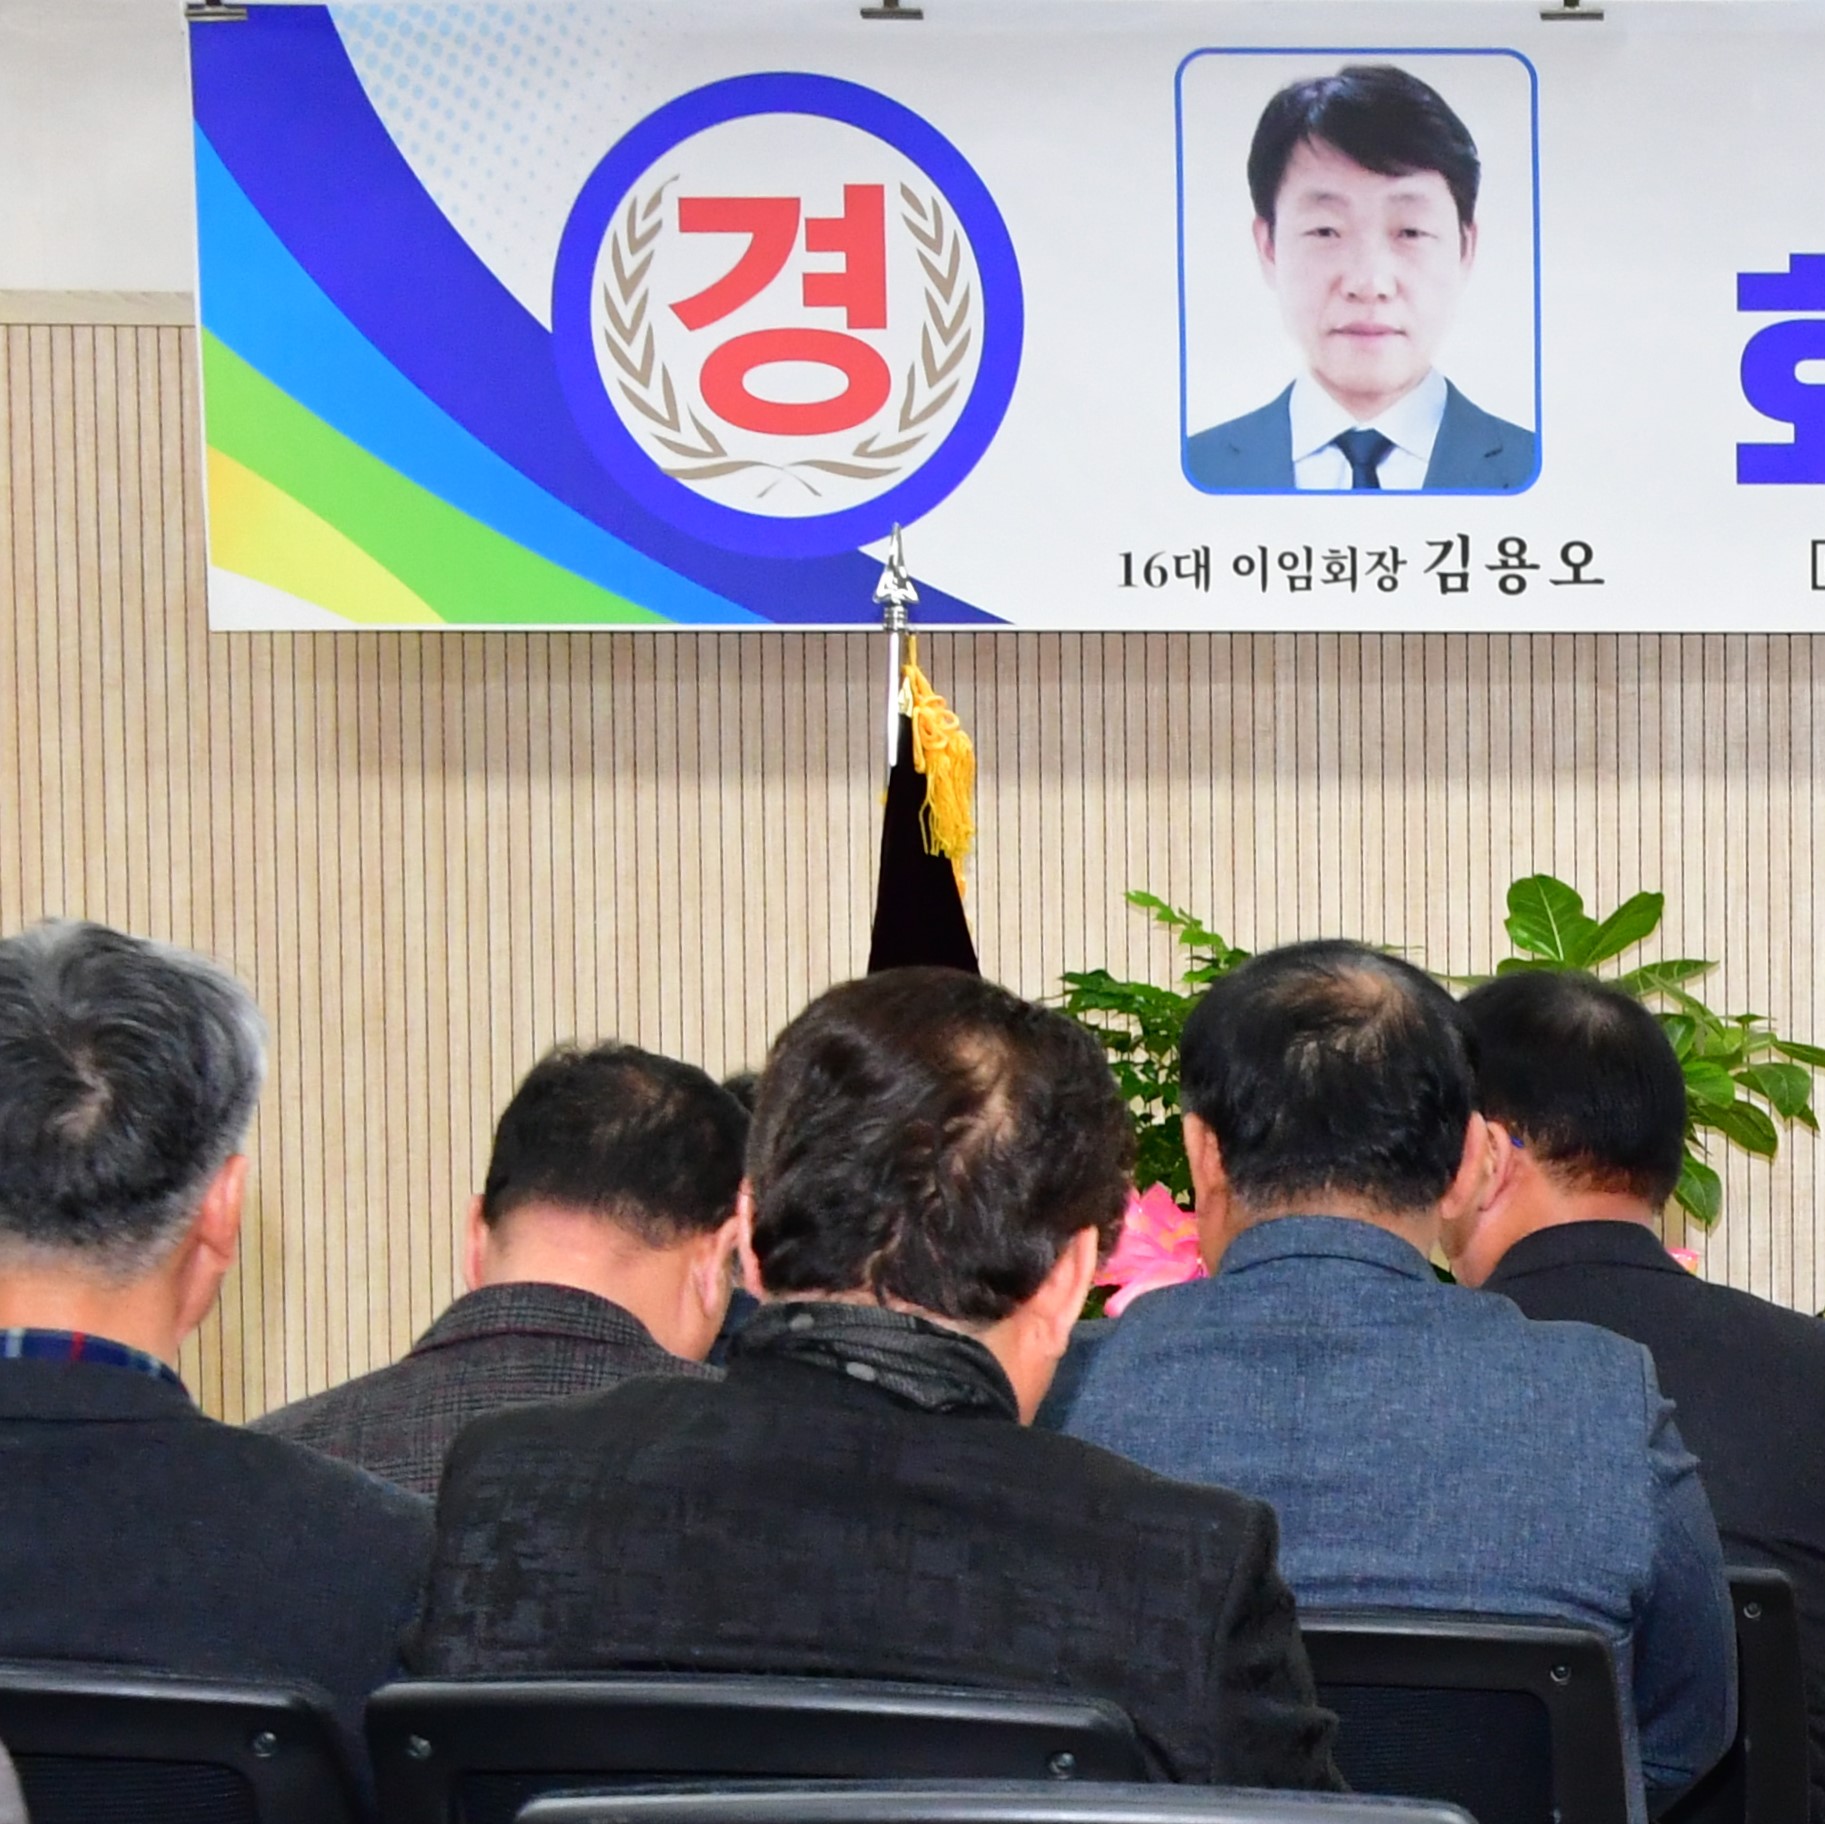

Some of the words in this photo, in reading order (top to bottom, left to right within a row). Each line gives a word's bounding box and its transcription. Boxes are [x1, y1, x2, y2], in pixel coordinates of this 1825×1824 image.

[672, 185, 890, 435] 경
[1118, 546, 1210, 592] 16대
[1233, 547, 1406, 592] 이임회장
[1423, 534, 1606, 595] 김용오
